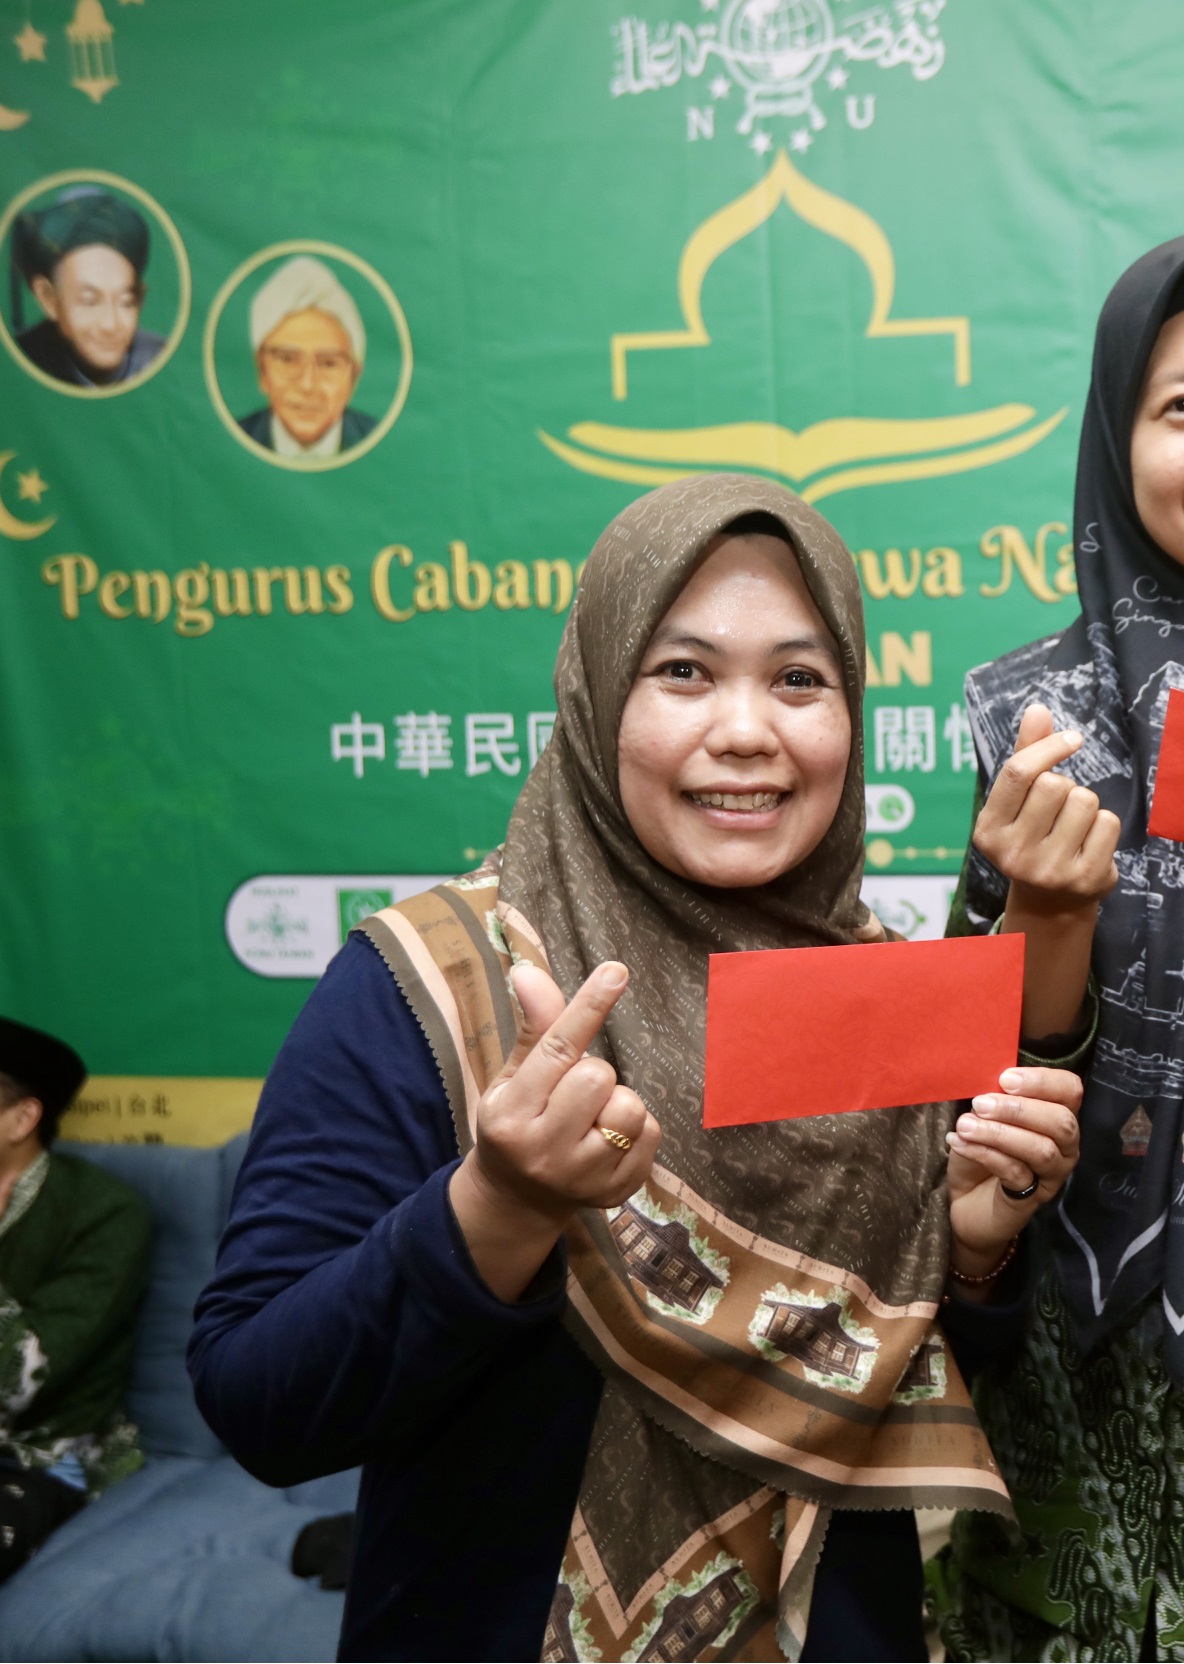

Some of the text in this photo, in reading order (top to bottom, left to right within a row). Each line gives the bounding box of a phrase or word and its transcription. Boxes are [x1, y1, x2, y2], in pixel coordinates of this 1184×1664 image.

[685, 94, 876, 142] N U
[42, 552, 355, 638] Pengurus
[370, 540, 588, 624] Caban
[853, 545, 964, 599] wa
[979, 521, 1078, 603] Na
